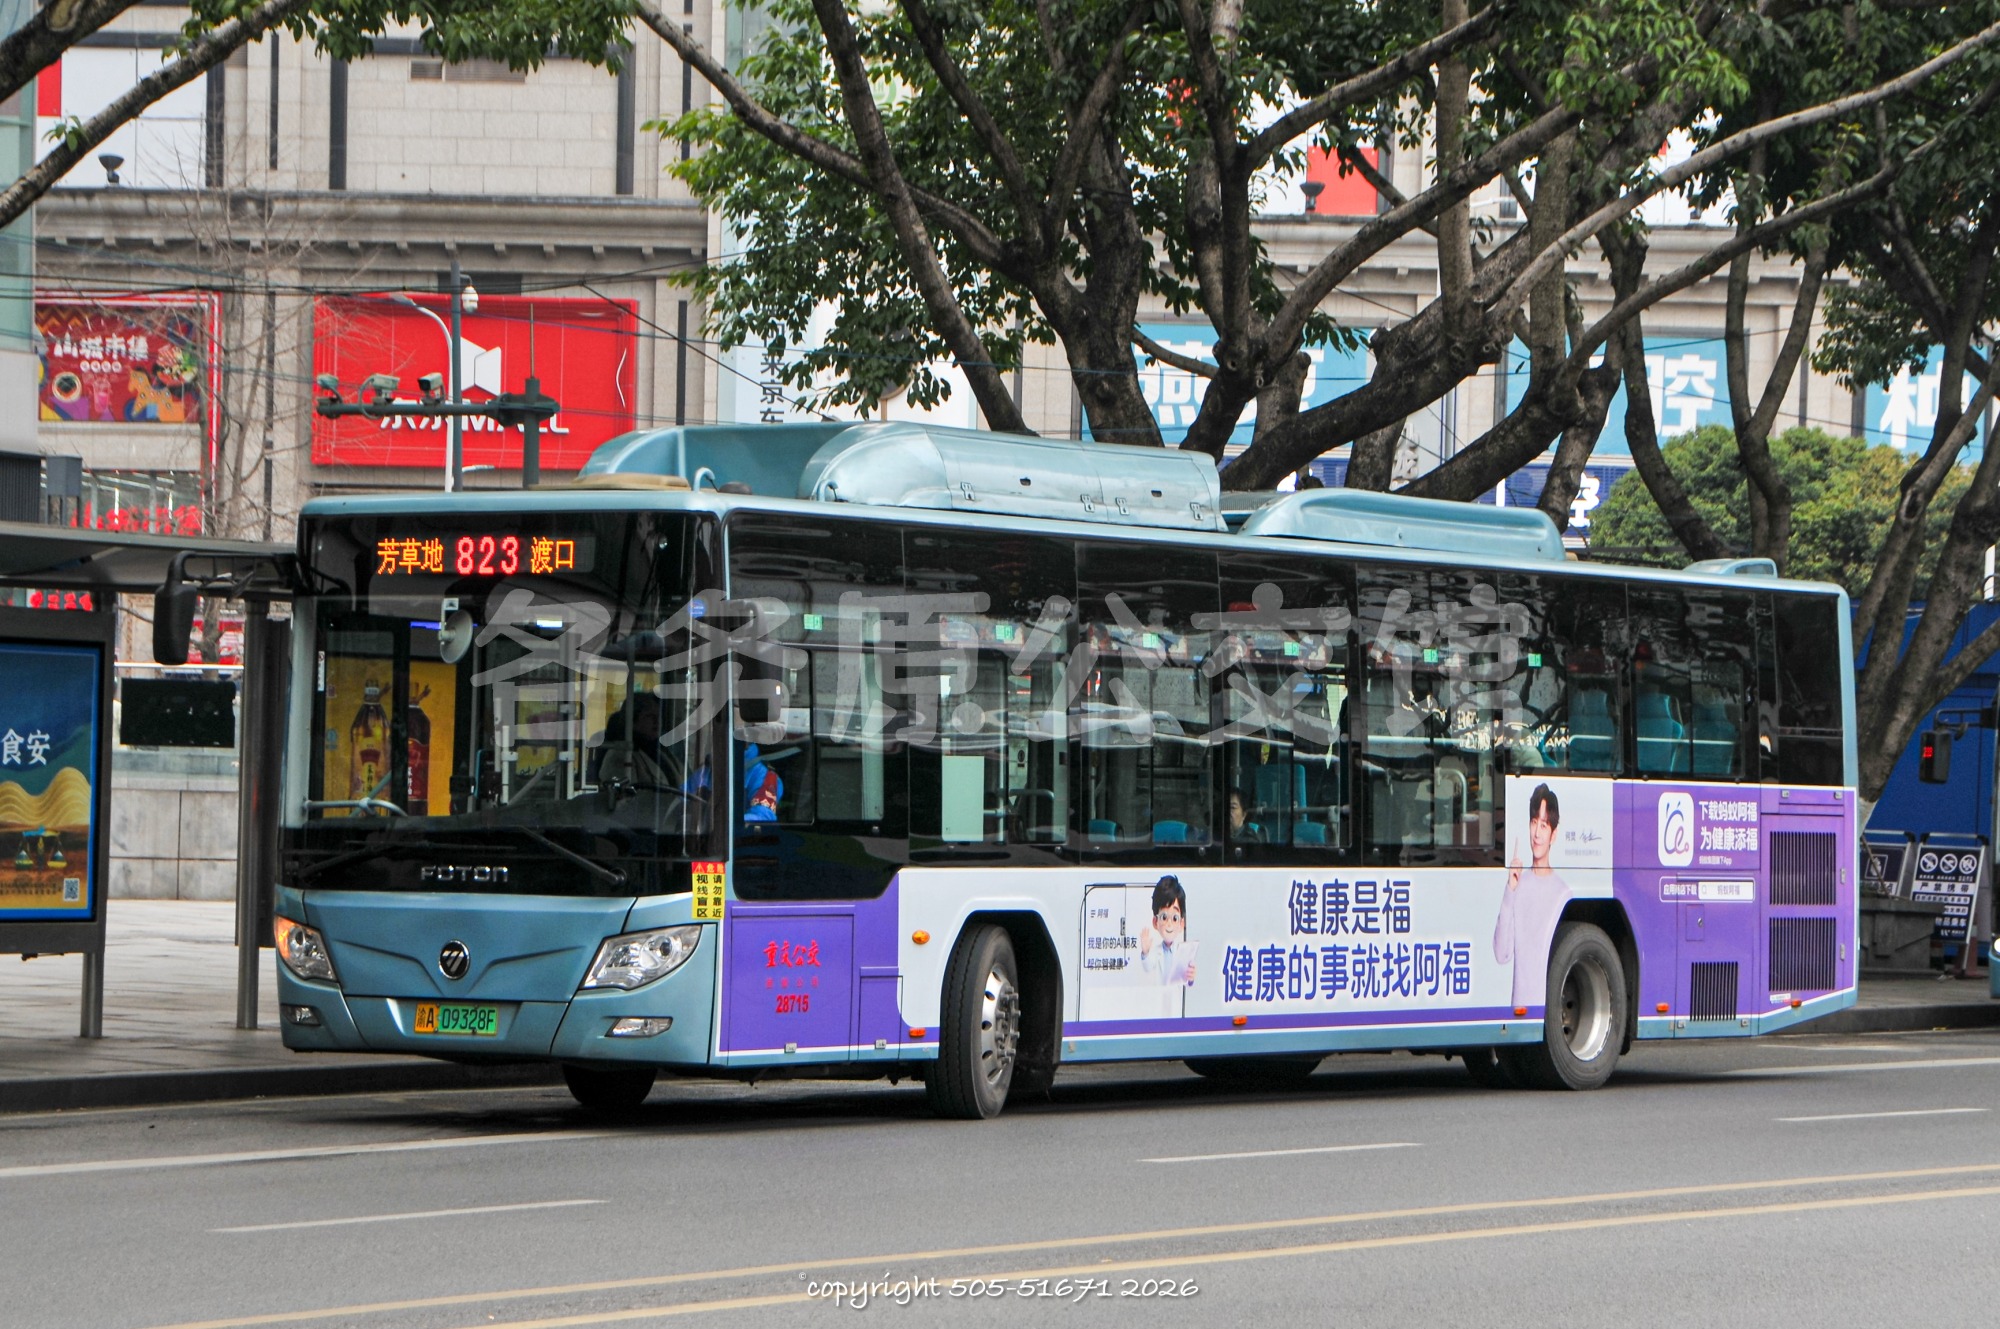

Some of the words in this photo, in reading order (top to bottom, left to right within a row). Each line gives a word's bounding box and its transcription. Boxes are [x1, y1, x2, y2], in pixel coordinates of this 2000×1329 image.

[377, 537, 443, 575] 芳草地
[455, 536, 519, 575] 823
[530, 537, 574, 574] 渡口
[1, 728, 50, 765] 食安
[1699, 800, 1757, 821] 下载蚂蚁阿福
[1700, 826, 1758, 851] 为健康添福
[421, 865, 508, 882] FOTON
[697, 874, 708, 917] 视线盲区
[712, 874, 723, 917] 请勿靠近
[1287, 878, 1411, 936] 健康是福
[1087, 936, 1138, 949] 我是你的AI朋友
[1221, 941, 1472, 1002] 健康的事就找阿福
[776, 994, 809, 1014] 28715
